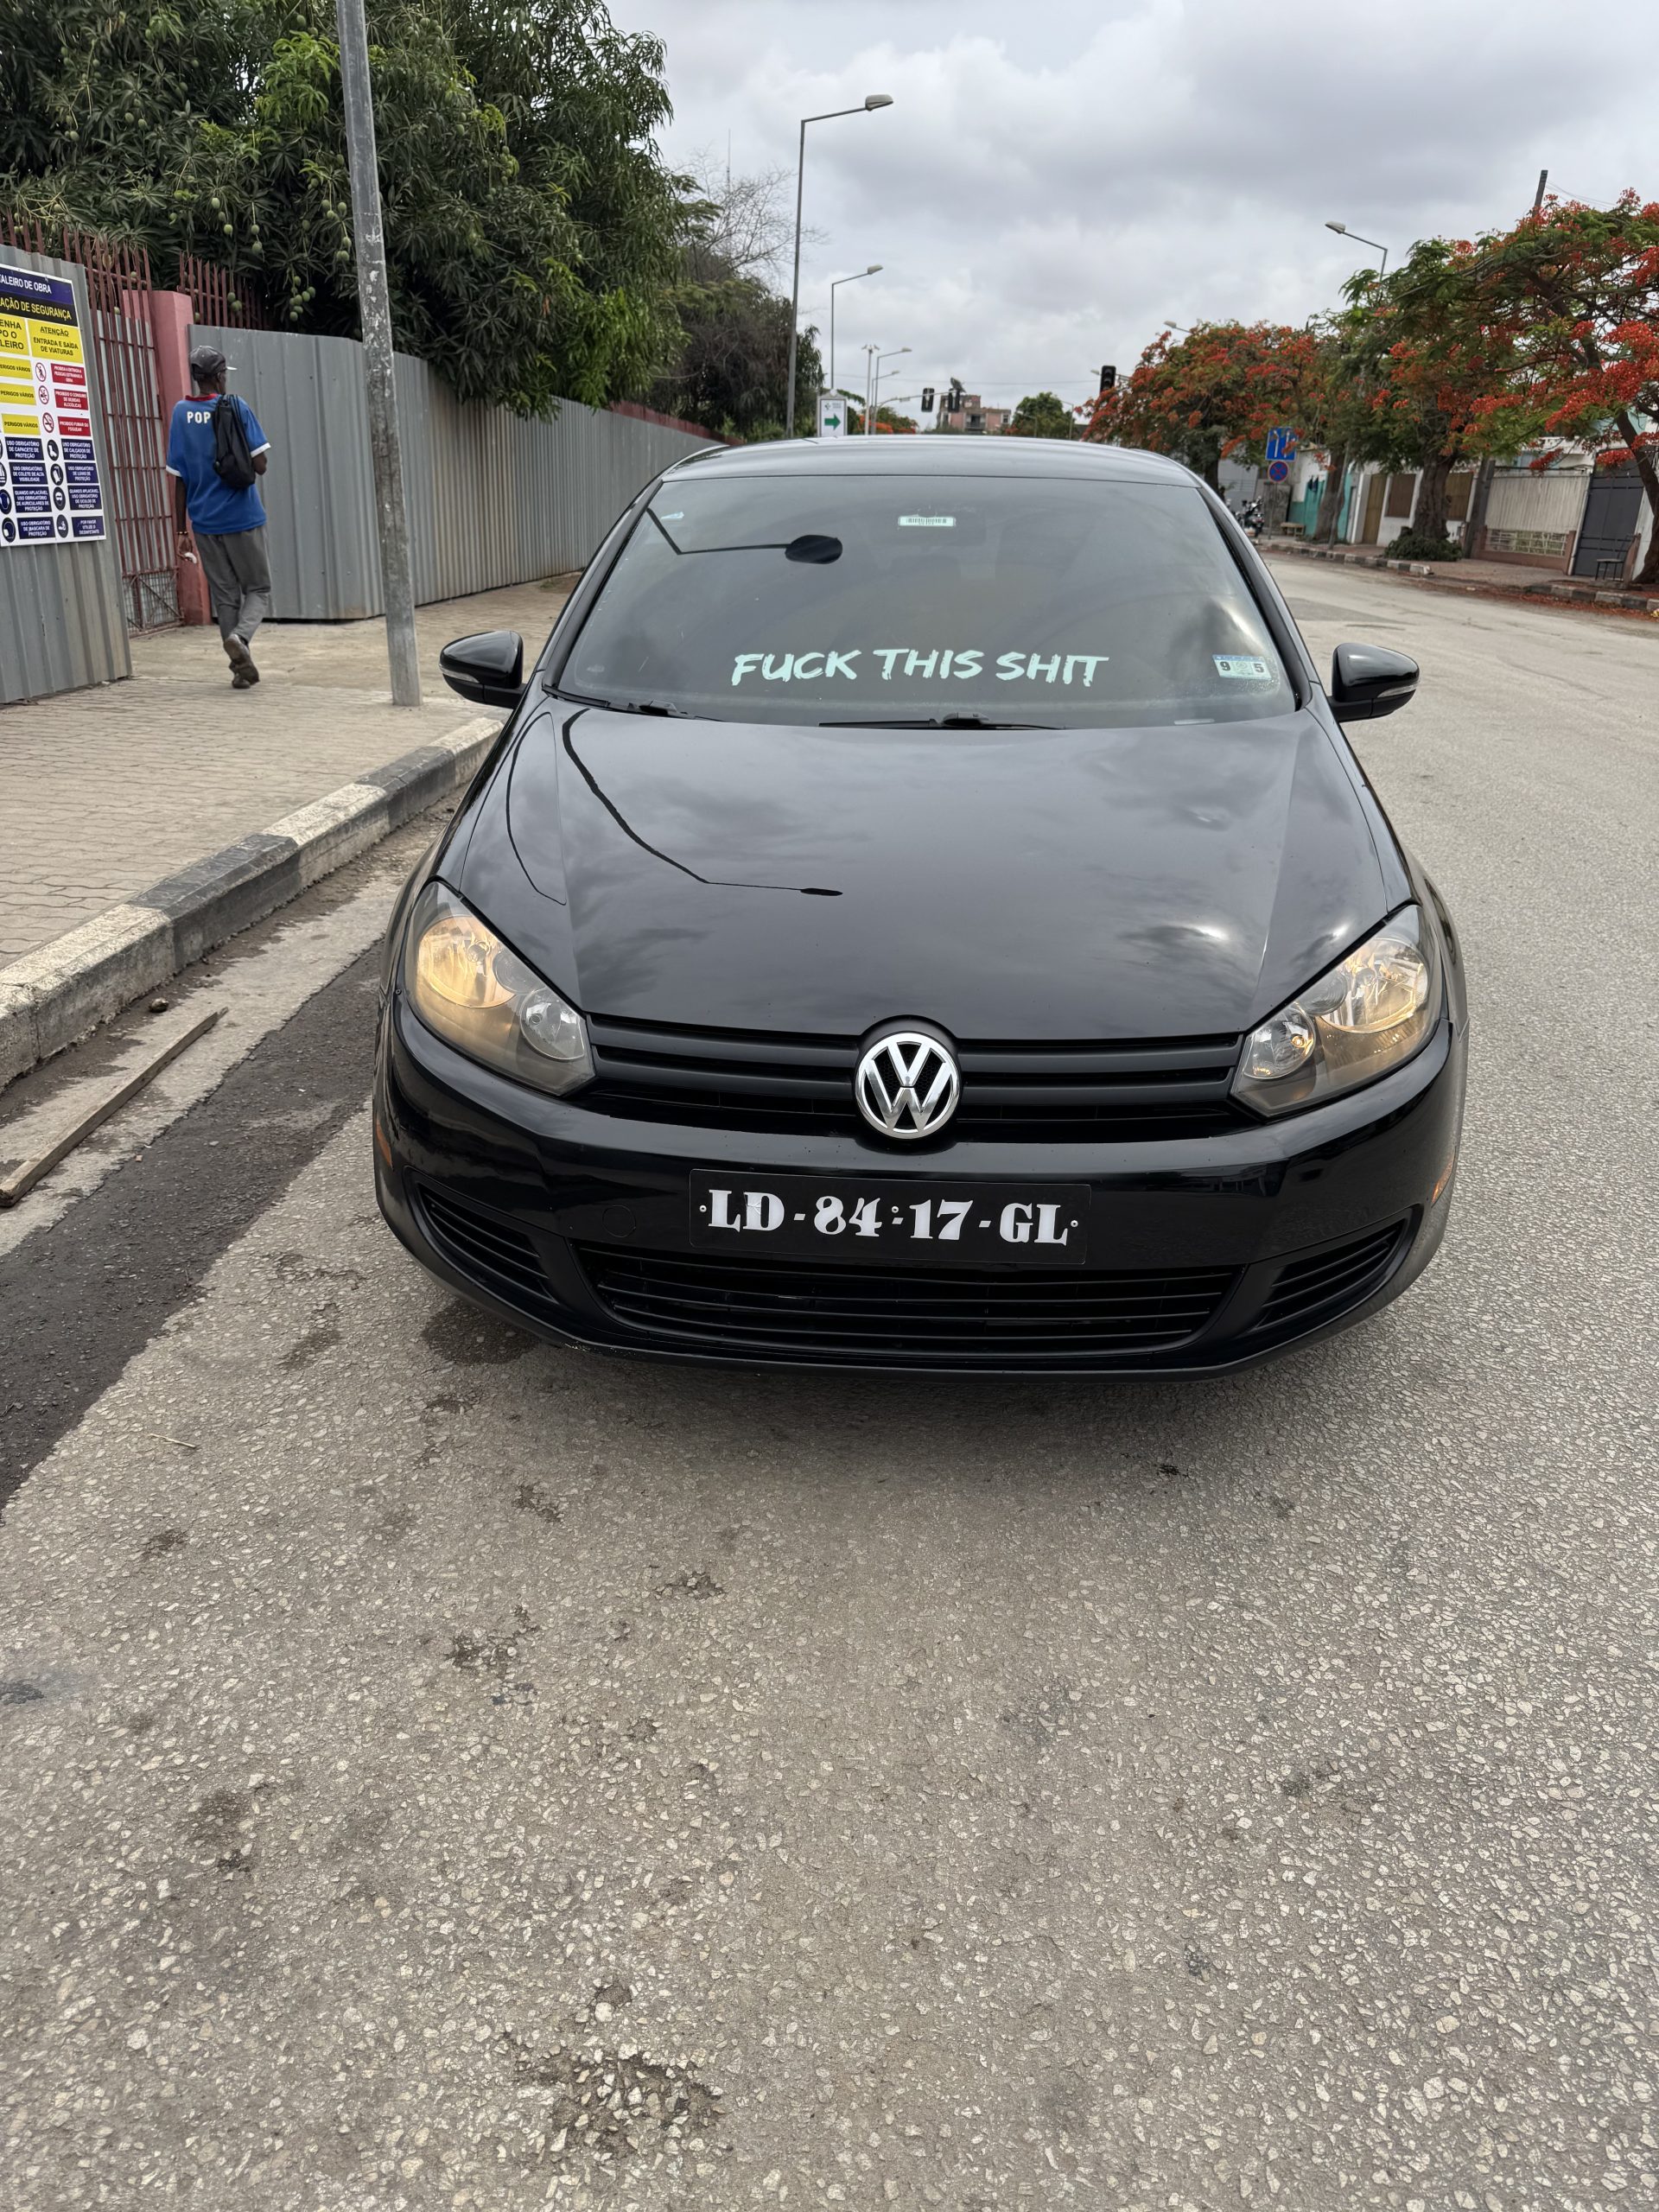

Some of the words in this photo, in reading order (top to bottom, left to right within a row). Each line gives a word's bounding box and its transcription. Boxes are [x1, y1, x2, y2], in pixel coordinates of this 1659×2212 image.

[24, 280, 33, 290] DE
[34, 283, 52, 294] OBRA
[21, 302, 30, 311] DE
[31, 304, 72, 321] SEGURANÇA
[41, 327, 69, 337] ATENÇÃO
[34, 337, 57, 346] ENTRADA
[49, 347, 73, 356] VIATURAS
[187, 411, 211, 423] POP
[731, 650, 861, 685] FUCK
[873, 648, 985, 680] THIS
[995, 652, 1109, 687] SHIT
[1220, 662, 1230, 671] 9
[1254, 664, 1264, 673] 5
